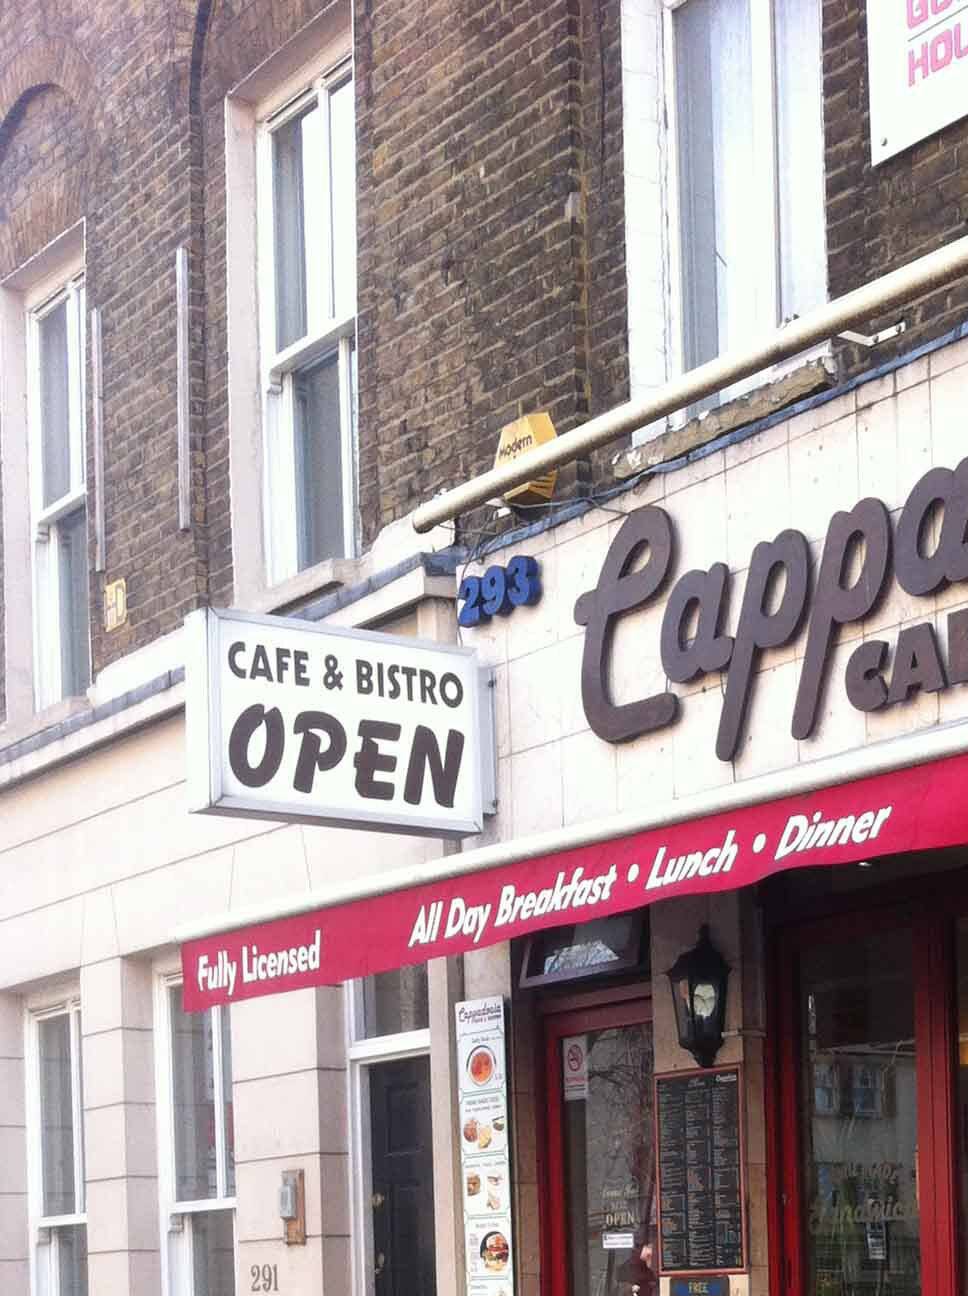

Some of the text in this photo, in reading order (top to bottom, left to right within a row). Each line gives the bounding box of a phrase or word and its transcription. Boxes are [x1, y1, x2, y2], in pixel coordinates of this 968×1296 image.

[458, 555, 543, 628] 293
[228, 641, 464, 708] CAFE & BISTRO
[229, 703, 465, 808] OPEN
[408, 806, 892, 947] All Day Breakfast Lunch Dinner
[197, 929, 321, 996] Fully Licensed
[251, 1264, 279, 1291] 291
